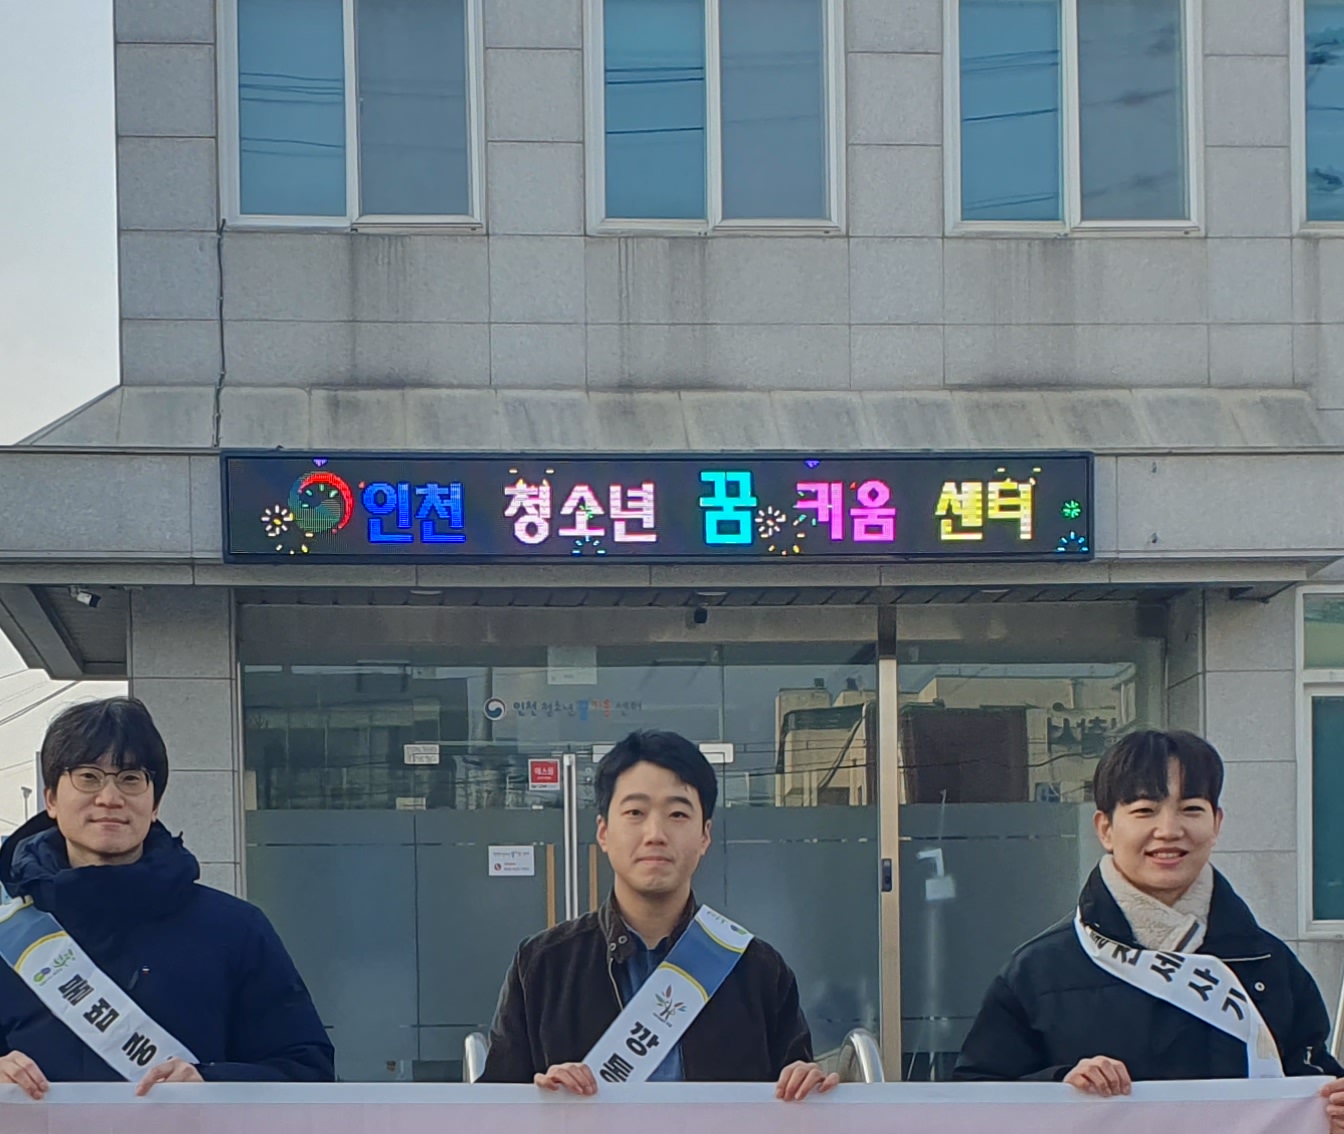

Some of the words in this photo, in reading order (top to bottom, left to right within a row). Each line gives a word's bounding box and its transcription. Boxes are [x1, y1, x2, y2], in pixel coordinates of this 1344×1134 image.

[362, 481, 466, 543] 인천
[504, 482, 658, 544] 청소년
[700, 471, 757, 545] 꿈
[793, 480, 896, 541] 키움
[935, 480, 1034, 541] 센터
[513, 701, 537, 716] 인천
[58, 974, 158, 1067] 불법중
